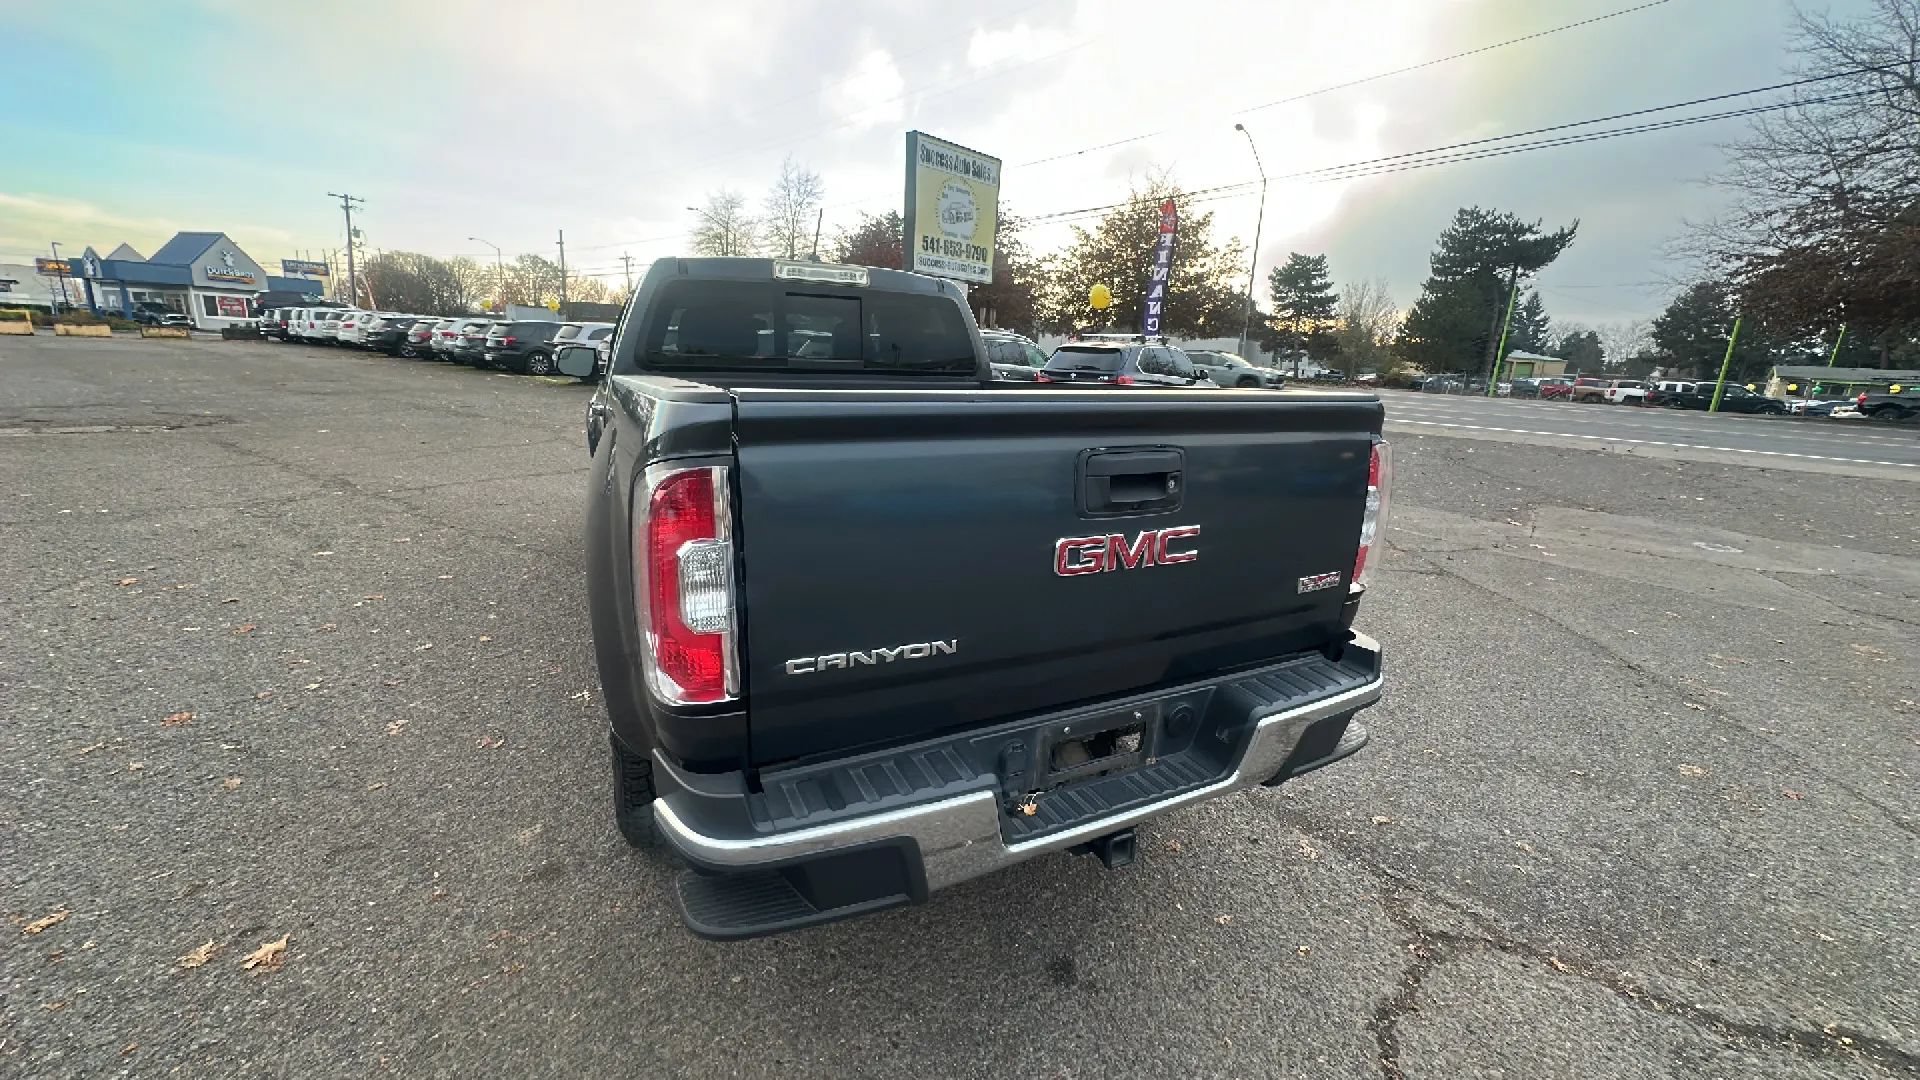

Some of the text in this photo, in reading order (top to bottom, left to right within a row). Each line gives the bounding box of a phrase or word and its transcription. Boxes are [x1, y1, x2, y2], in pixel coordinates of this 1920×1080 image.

[920, 143, 991, 182] Success Auto Sales
[1054, 524, 1201, 577] GMC
[785, 639, 958, 676] CANYON
